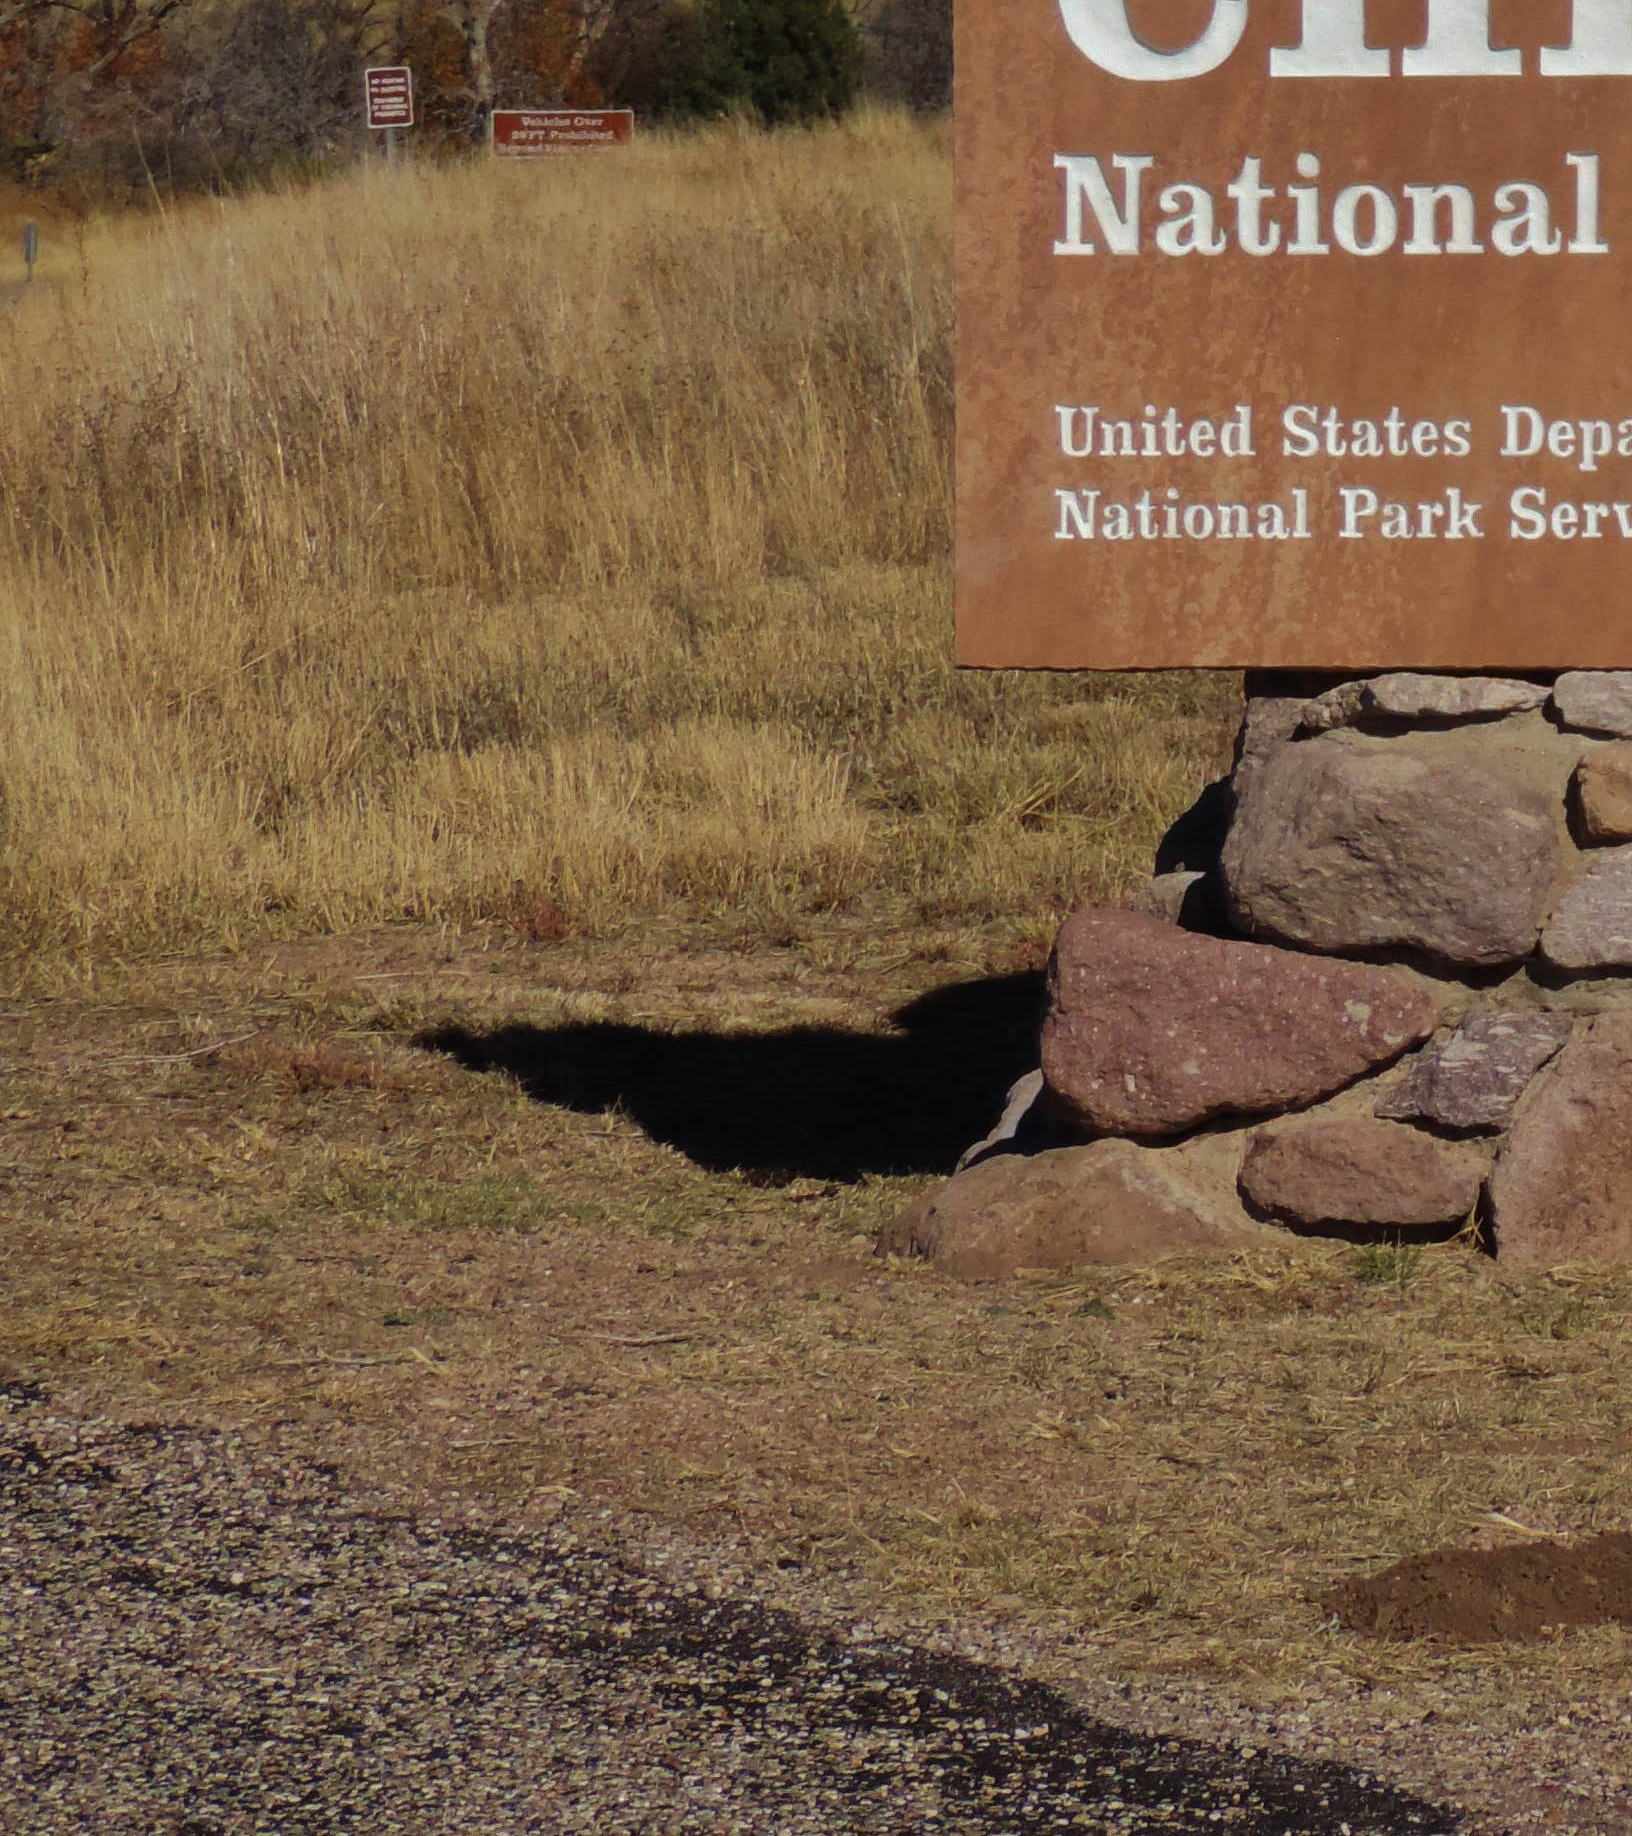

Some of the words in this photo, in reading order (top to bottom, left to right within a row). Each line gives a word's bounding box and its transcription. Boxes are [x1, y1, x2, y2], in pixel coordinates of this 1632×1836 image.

[1053, 152, 1609, 257] National
[1054, 404, 1257, 458] United
[1282, 404, 1471, 458] States
[1053, 487, 1312, 541] National
[1338, 486, 1485, 541] Park
